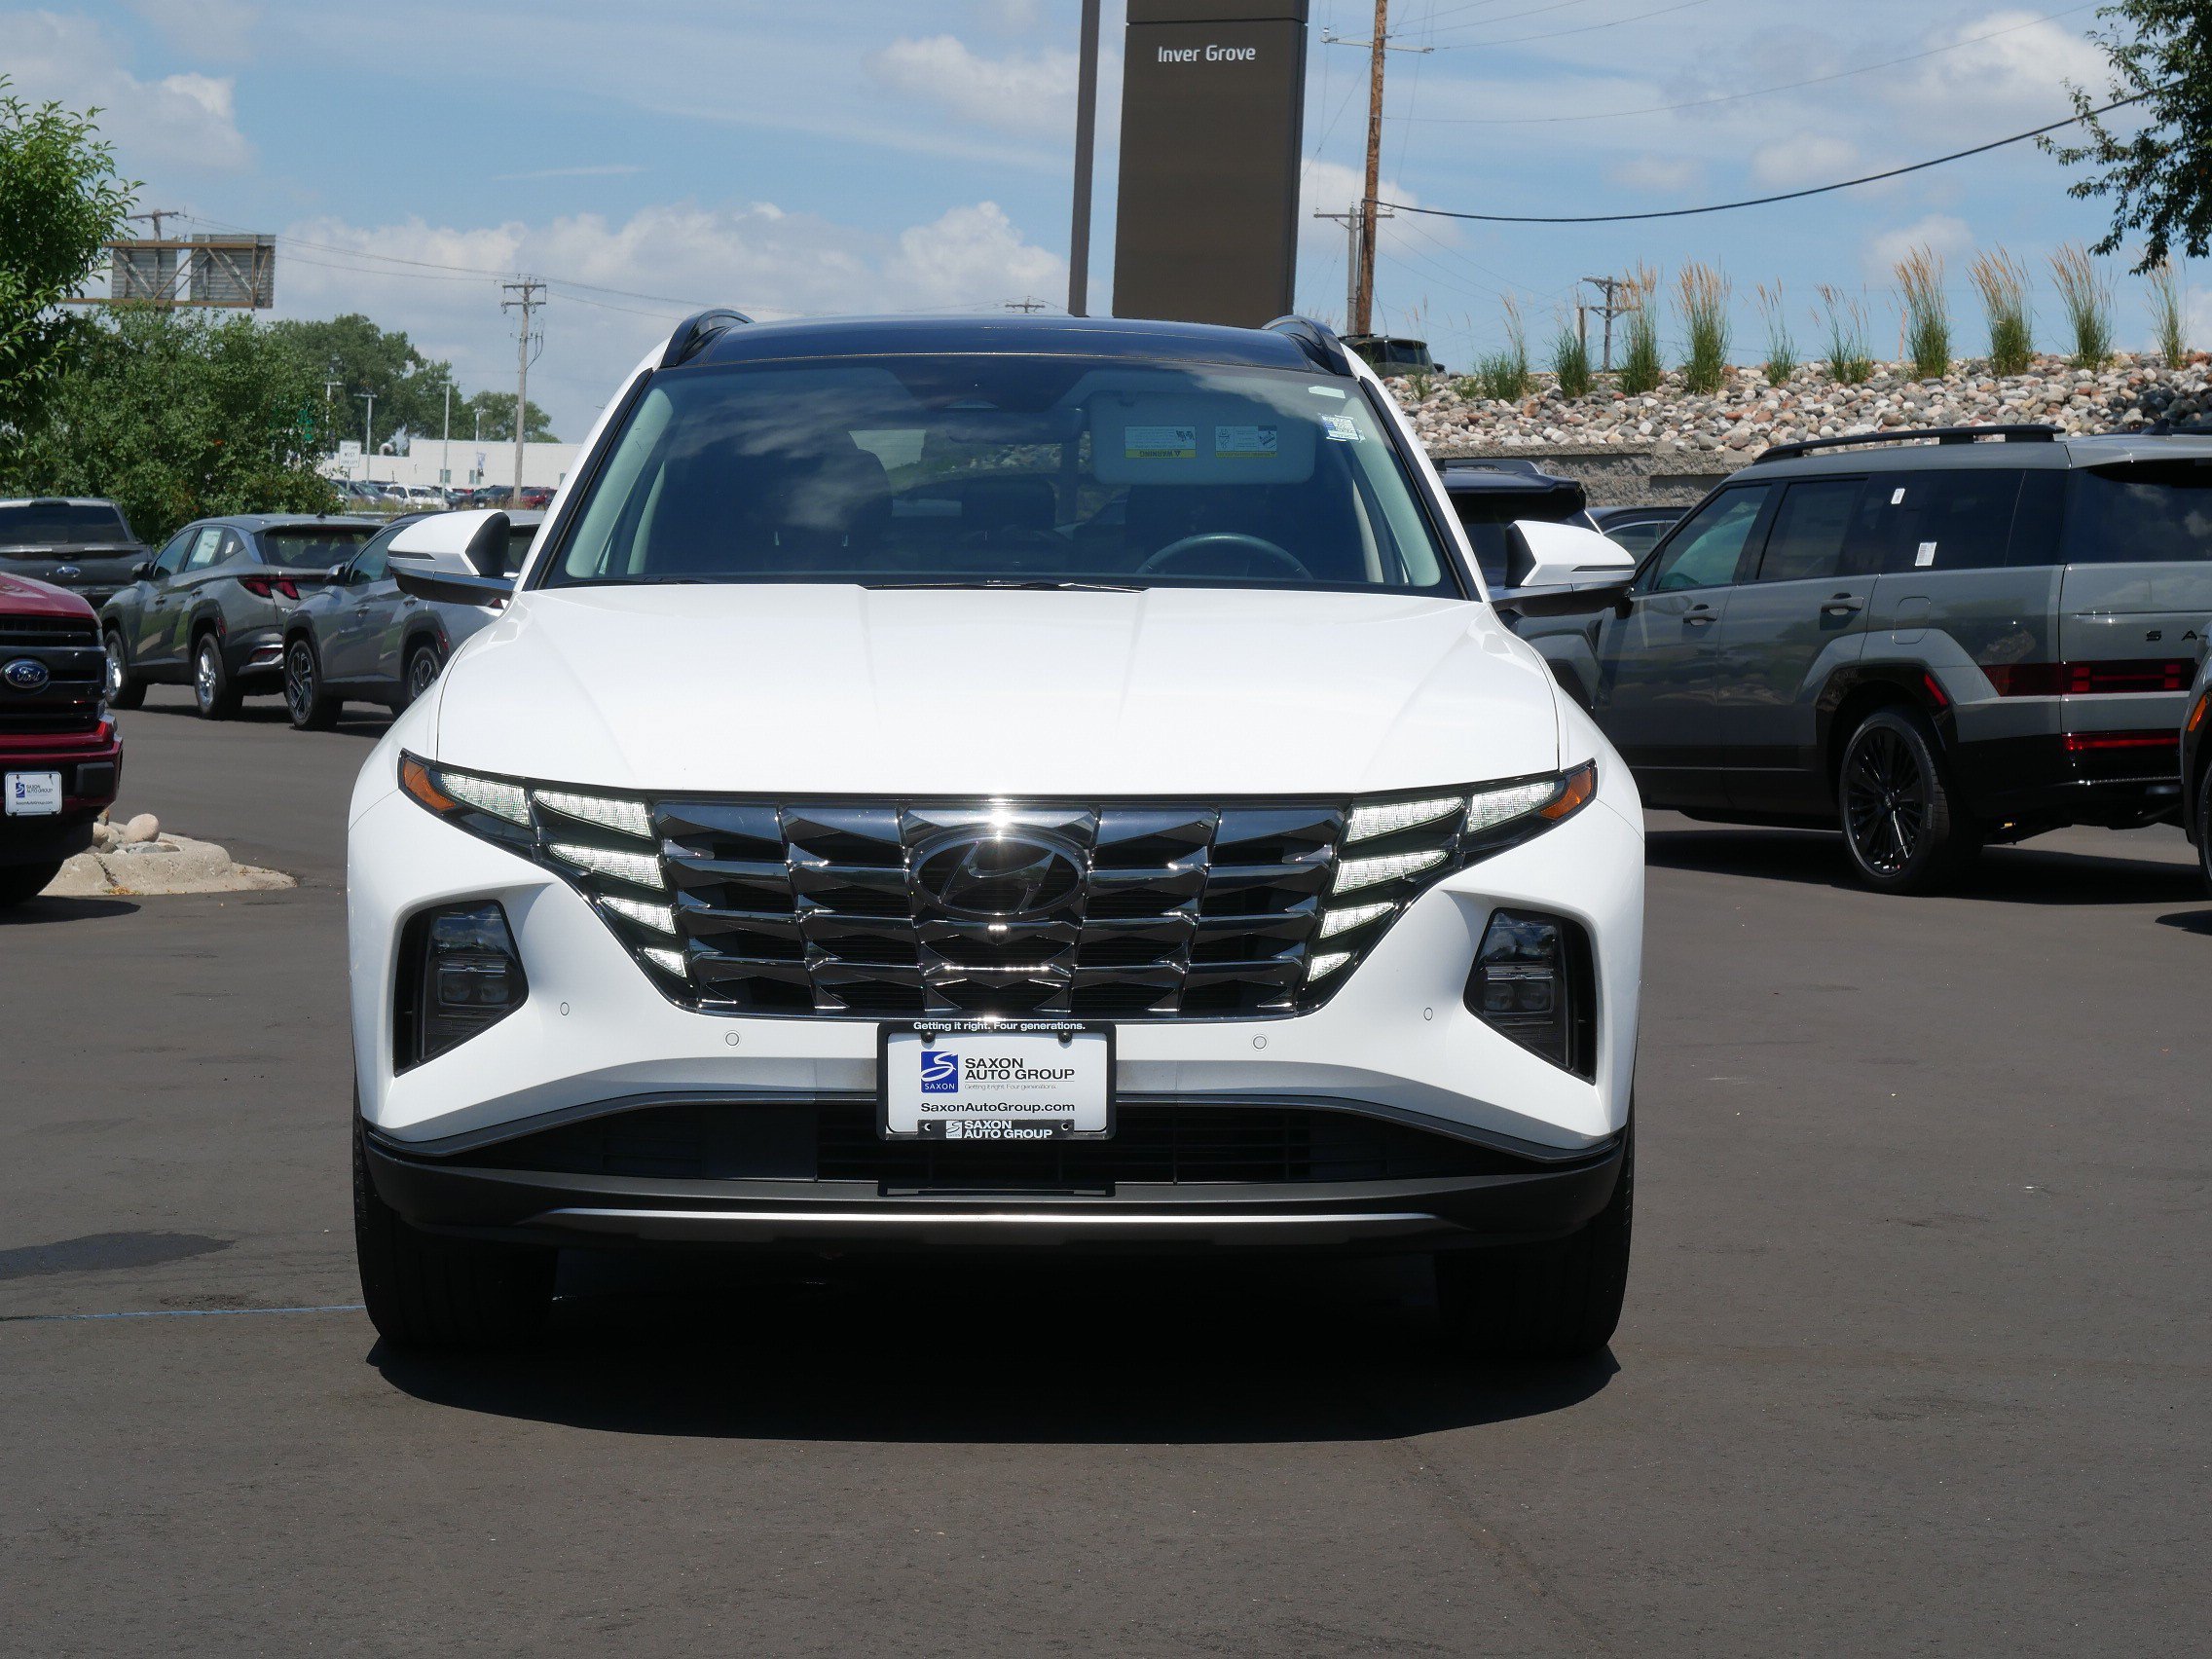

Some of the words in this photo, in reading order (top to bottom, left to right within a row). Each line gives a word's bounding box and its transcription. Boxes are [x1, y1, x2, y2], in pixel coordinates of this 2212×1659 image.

[1158, 46, 1200, 62] Inver
[1205, 45, 1257, 61] Grove
[17, 666, 41, 682] Ford
[913, 1022, 951, 1032] Getting
[964, 1022, 991, 1032] right.
[1020, 1022, 1087, 1032] generations.
[964, 1057, 1024, 1069] SAXON
[964, 1069, 1011, 1081] AUTO
[1014, 1068, 1076, 1081] GROUP
[921, 1102, 1076, 1114] SaxonAutoGroup.com
[964, 1120, 1013, 1129] SAXON
[964, 1129, 1001, 1139] AUTO
[1004, 1128, 1053, 1139] GROUP
